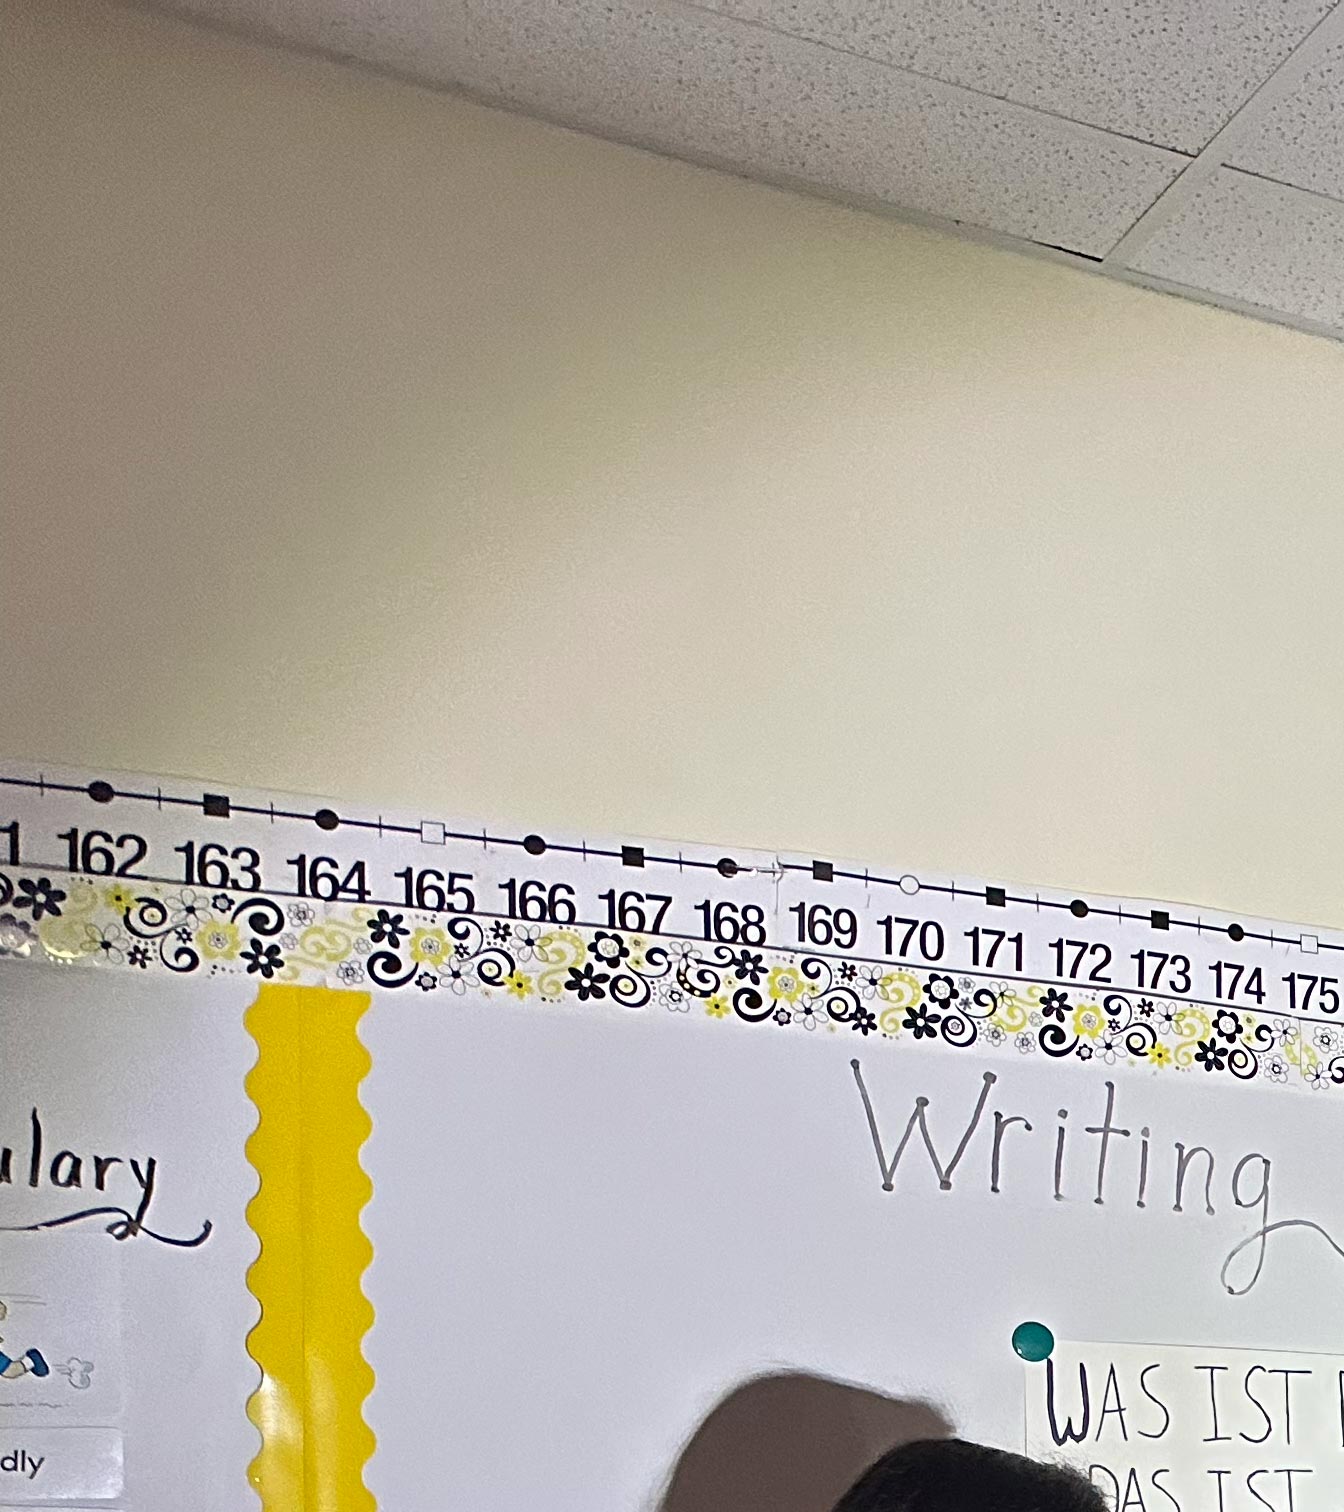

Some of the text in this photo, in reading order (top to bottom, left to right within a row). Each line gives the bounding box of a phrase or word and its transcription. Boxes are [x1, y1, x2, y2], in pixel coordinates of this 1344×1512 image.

[57, 828, 148, 880] 162
[174, 842, 262, 893] 163
[286, 854, 371, 903] 164
[394, 867, 476, 914] 165
[497, 879, 577, 926] 166
[597, 890, 673, 935] 167
[693, 900, 767, 945] 168
[788, 901, 858, 949] 169
[877, 915, 945, 961] 170
[963, 926, 1025, 972] 171
[1048, 938, 1113, 983] 172
[1131, 949, 1192, 994] 173
[1208, 960, 1266, 1005] 174
[1282, 971, 1340, 1014] 175
[850, 1057, 1272, 1295] Writing
[1046, 1357, 1171, 1447] WAS
[1194, 1364, 1313, 1446] IST
